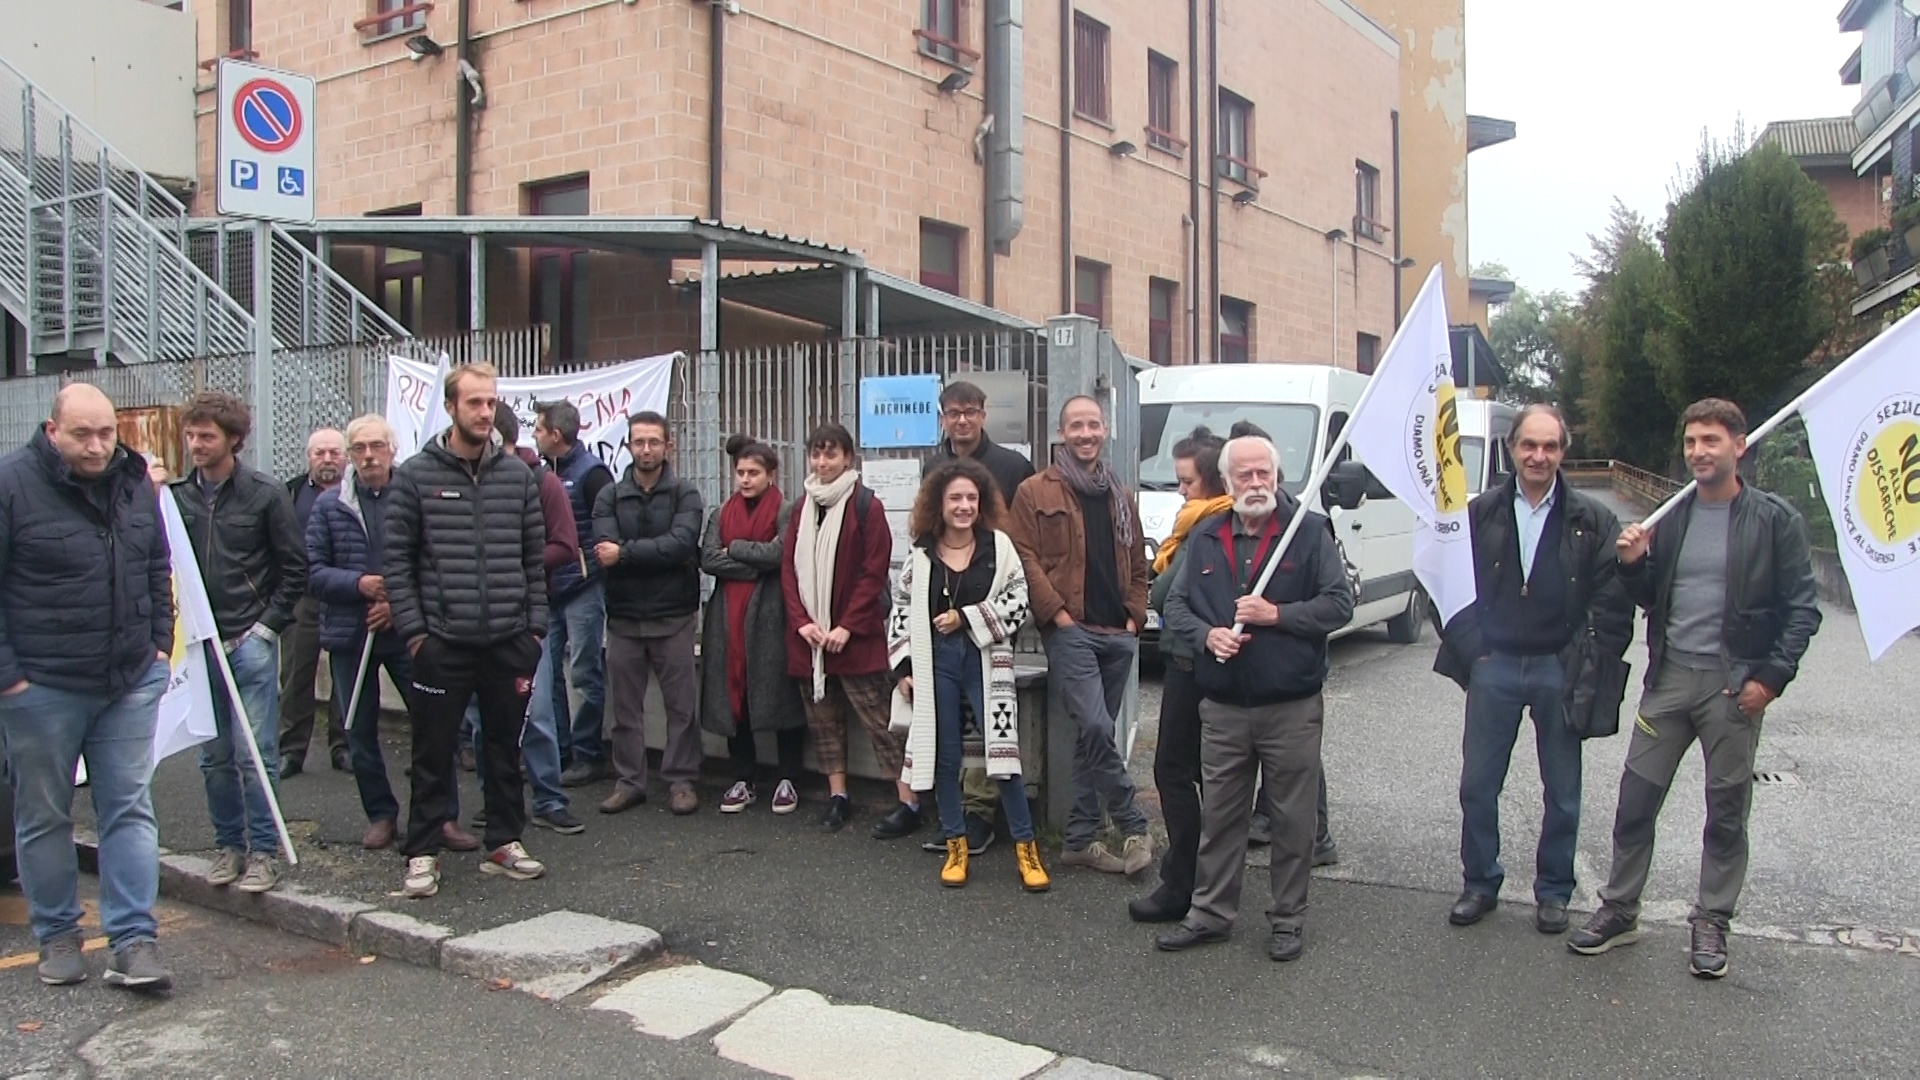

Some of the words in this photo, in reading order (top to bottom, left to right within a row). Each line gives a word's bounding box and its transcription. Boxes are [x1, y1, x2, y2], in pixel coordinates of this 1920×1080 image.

[235, 161, 254, 187] P
[1057, 329, 1072, 344] 17
[564, 387, 632, 430] CNA
[873, 401, 931, 416] ARCHIMEDE
[1413, 414, 1425, 459] DIAMO
[1416, 460, 1433, 488] UNA
[1889, 466, 1903, 506] ALLE
[1866, 447, 1897, 541] DISCARICHE
[1853, 535, 1866, 549] AL
